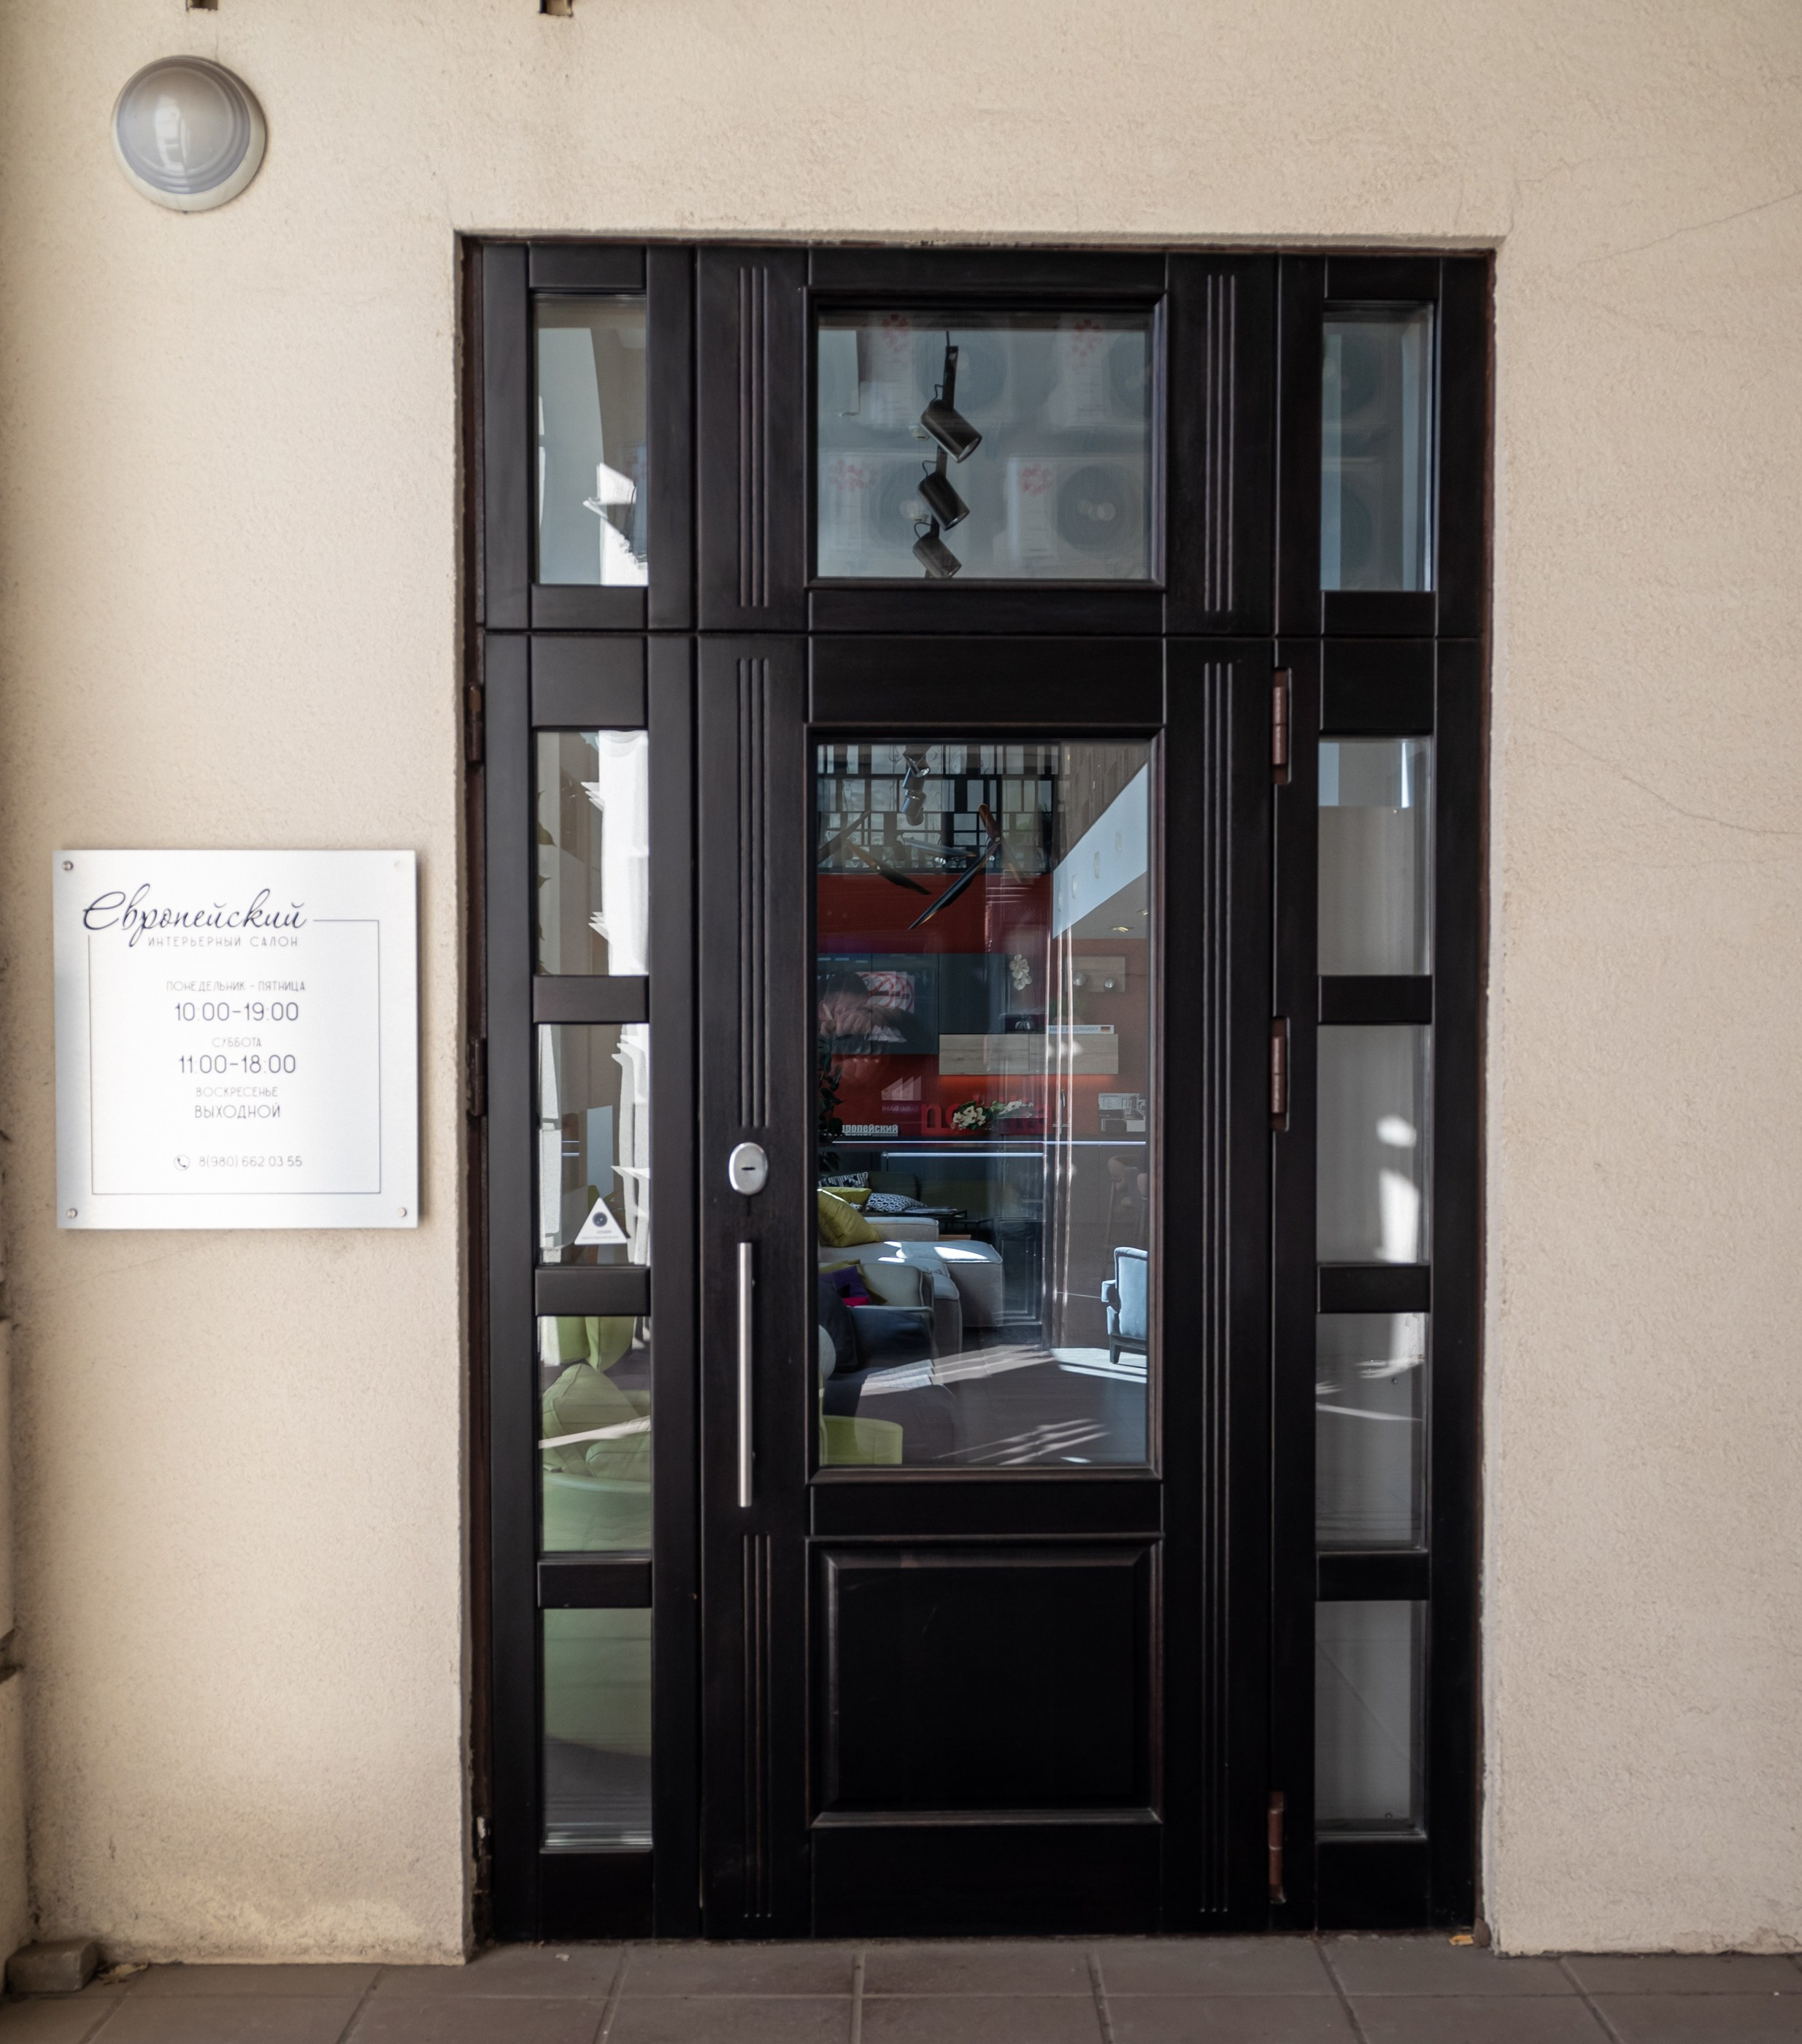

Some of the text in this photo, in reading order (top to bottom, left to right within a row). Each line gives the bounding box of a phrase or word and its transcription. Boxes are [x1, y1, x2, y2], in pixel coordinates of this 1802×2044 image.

[82, 883, 307, 948] Европейский
[147, 935, 298, 947] ИНТЕРЬЕРНЫЙ САЛОН
[166, 981, 245, 992] ПОНЕДЕЛЬНИК
[258, 981, 306, 992] ПЯТНИЦА
[174, 1002, 299, 1021] 10:00-19:00
[212, 1037, 262, 1048] СУББОТА
[178, 1055, 296, 1074] 11:00-18:00
[196, 1086, 278, 1097] ВОСКРЕСЕНЬЕ
[195, 1102, 281, 1120] ВЫХОДНОЙ
[199, 1156, 303, 1168] 8(980) 662 03 55
